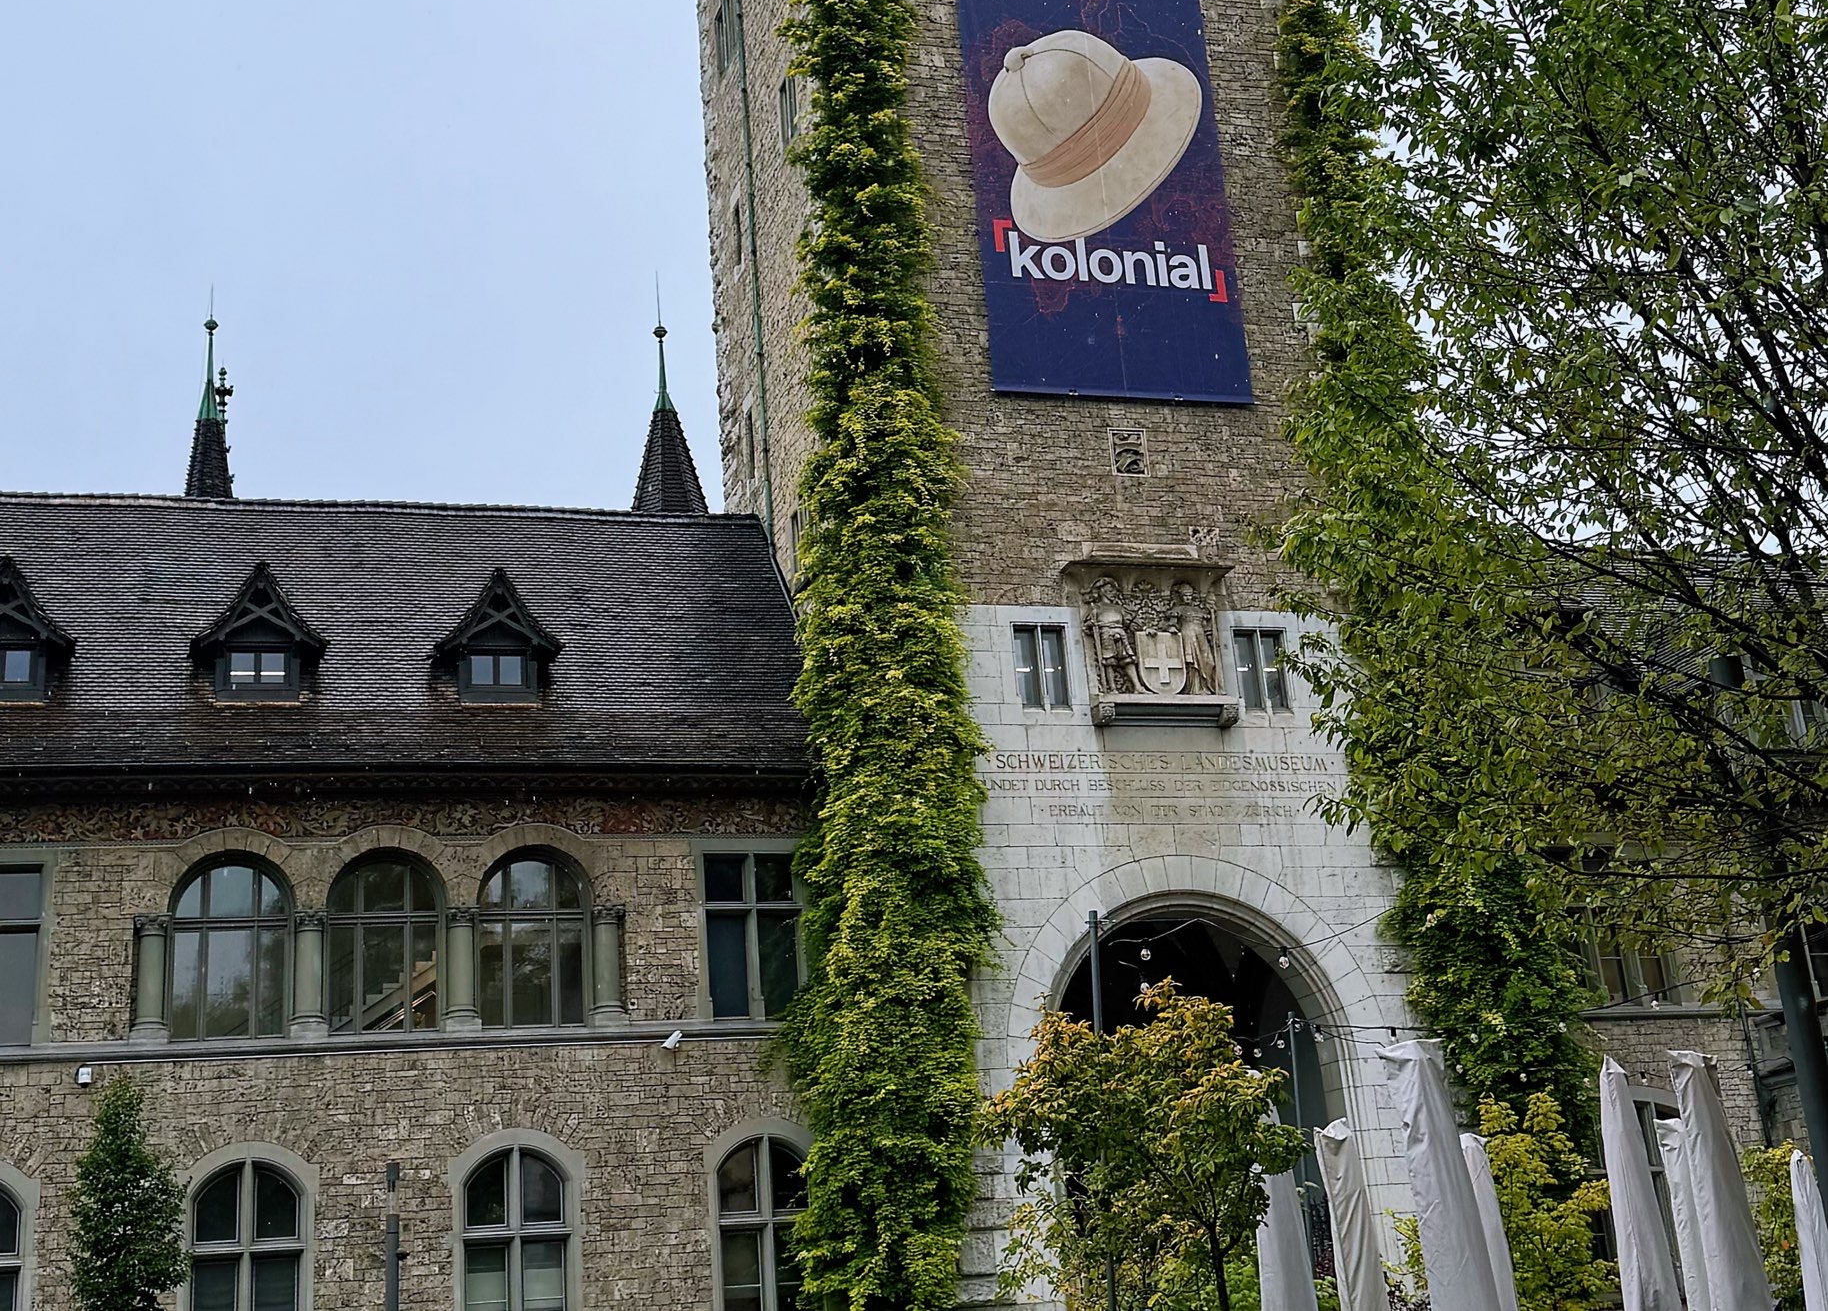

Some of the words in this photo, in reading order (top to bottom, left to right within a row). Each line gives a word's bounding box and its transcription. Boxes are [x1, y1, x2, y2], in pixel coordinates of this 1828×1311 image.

[1008, 231, 1212, 290] kolonial
[995, 753, 1169, 771] SCHWEIZERISCHES
[1180, 755, 1328, 772] LANDESMUSEUM
[1034, 778, 1080, 791] DURCH
[1087, 778, 1166, 792] BESCHLUSS
[1174, 779, 1202, 792] DER
[1049, 803, 1104, 817] ERBAUT
[1111, 804, 1142, 818] VON
